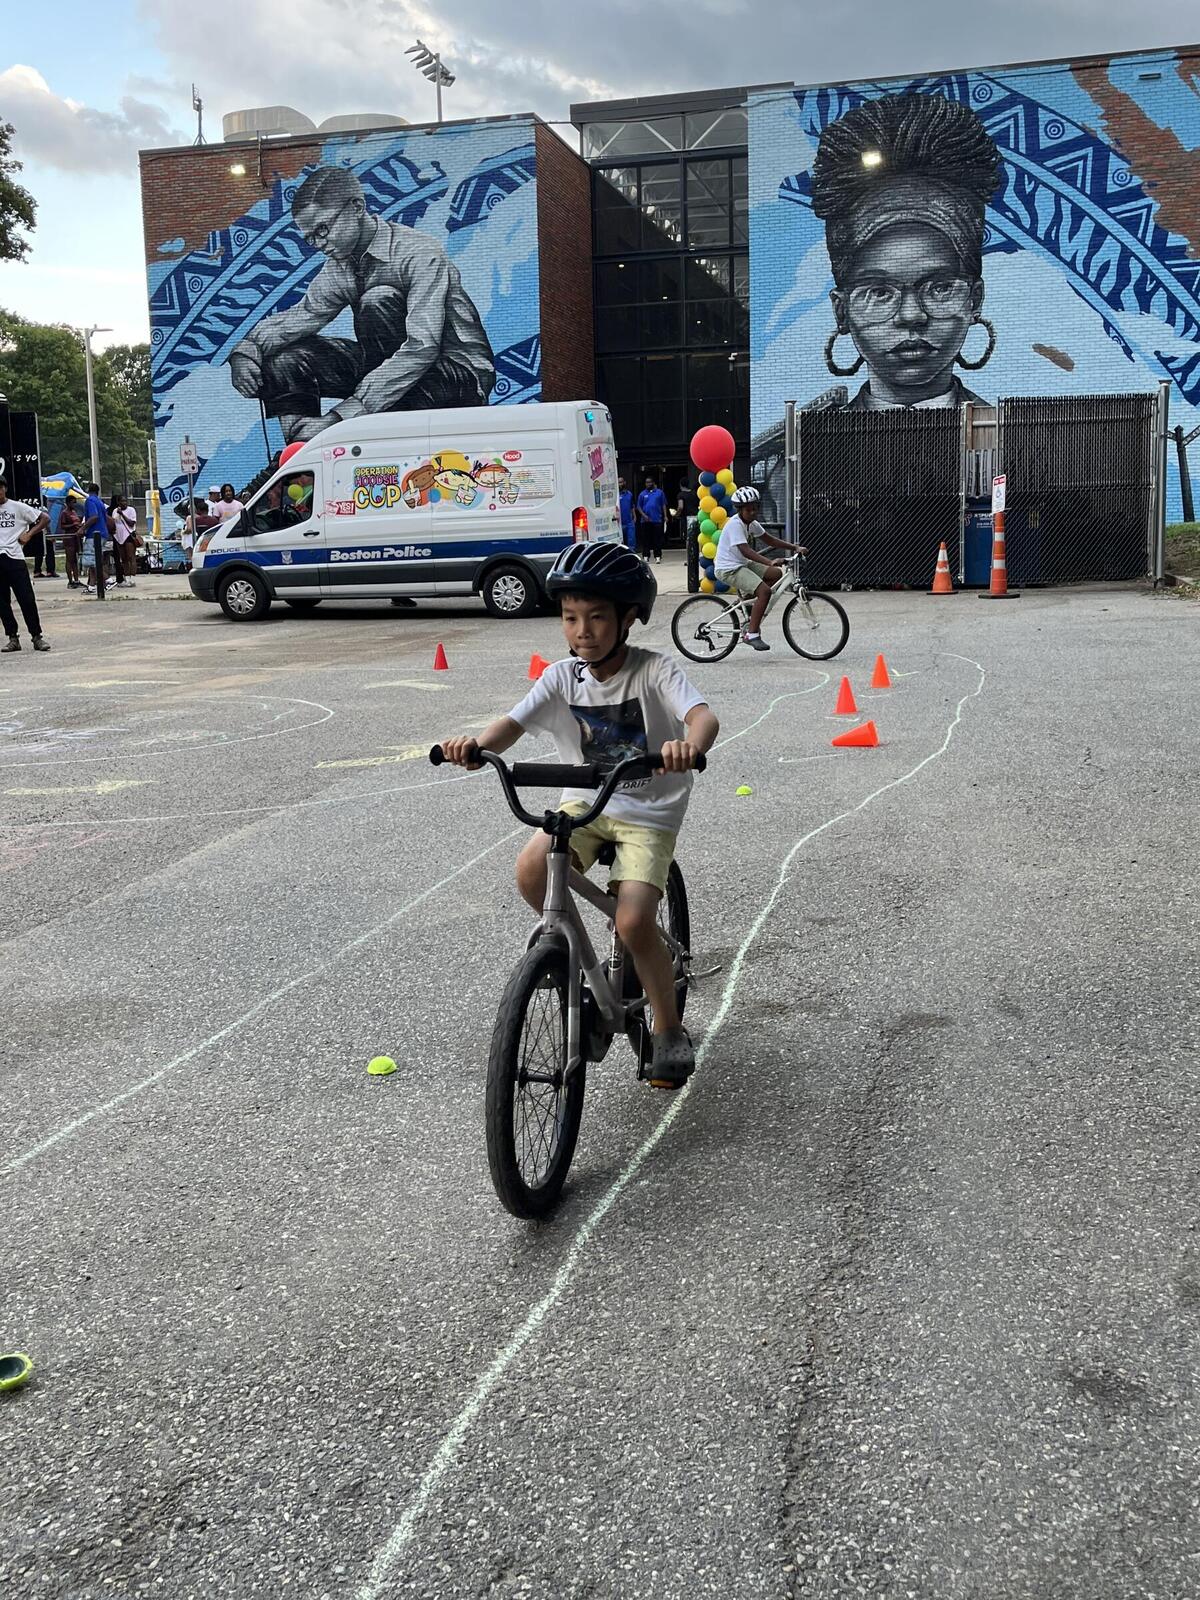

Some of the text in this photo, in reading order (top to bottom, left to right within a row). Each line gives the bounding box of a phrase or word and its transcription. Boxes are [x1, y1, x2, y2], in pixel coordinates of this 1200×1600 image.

[504, 452, 520, 460] Hood
[354, 465, 399, 477] OPERATION
[354, 475, 399, 487] HOODSIE
[353, 484, 402, 510] CUP
[338, 501, 355, 513] YES!
[330, 545, 432, 562] Boston Police
